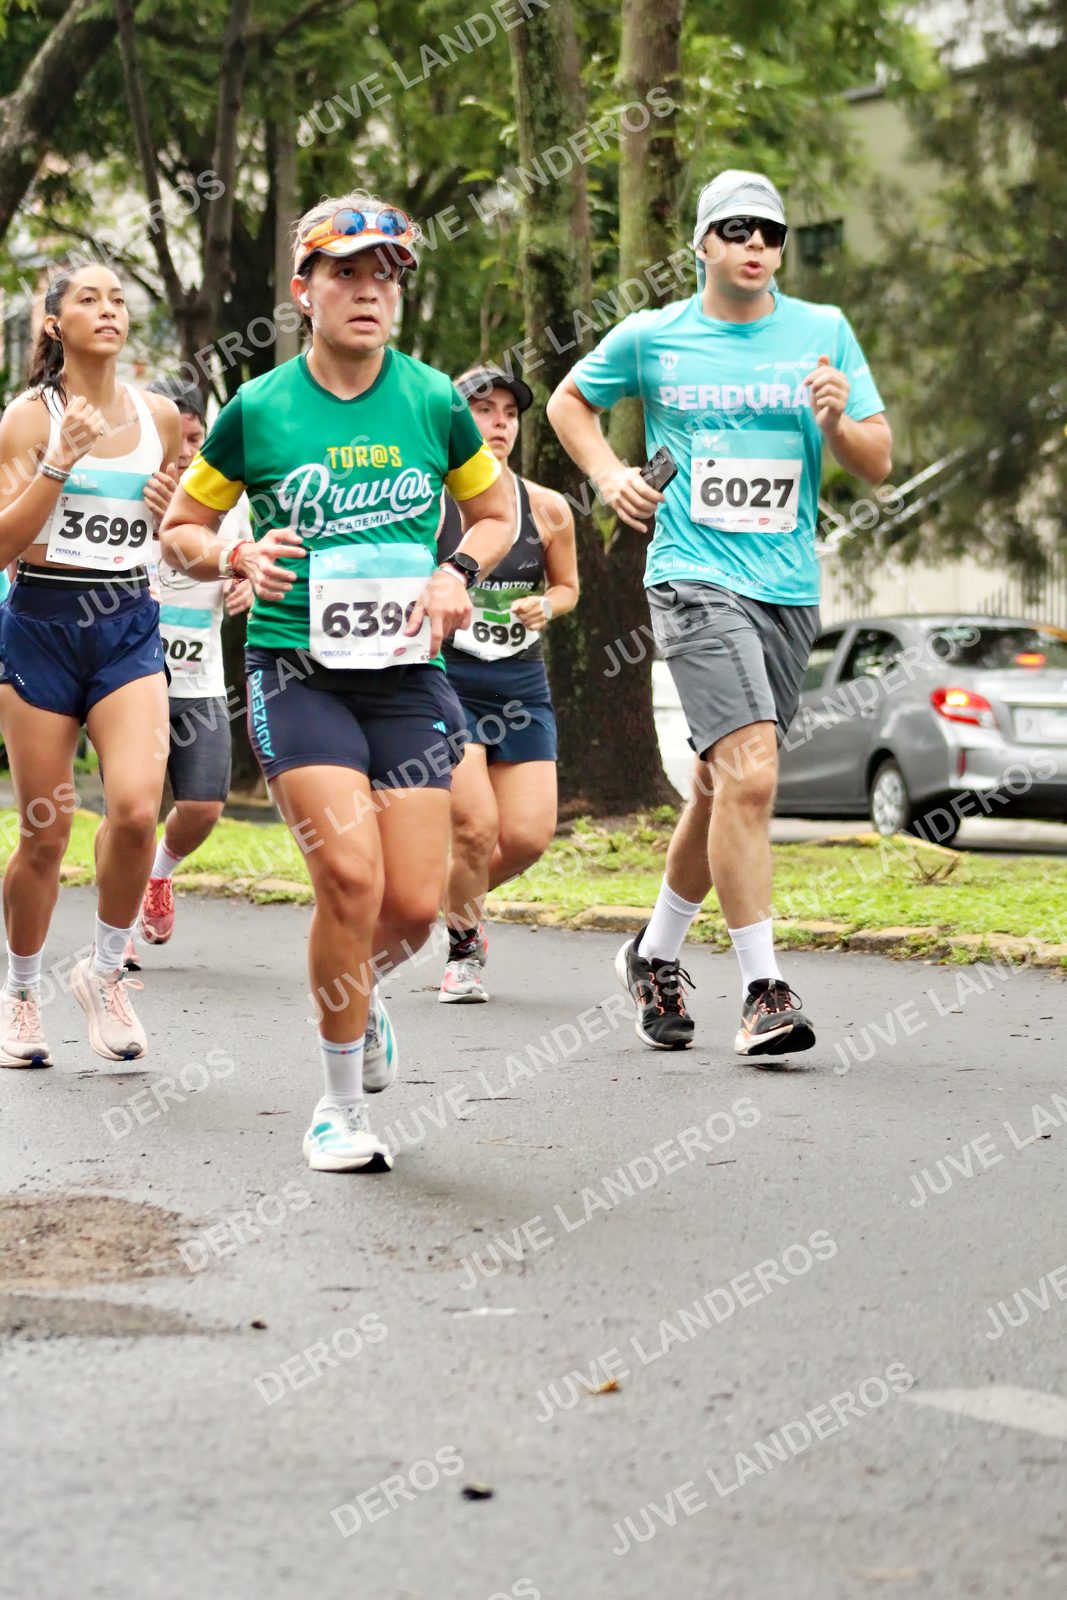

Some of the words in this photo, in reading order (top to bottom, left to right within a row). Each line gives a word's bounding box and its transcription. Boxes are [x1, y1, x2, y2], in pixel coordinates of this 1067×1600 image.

[658, 383, 812, 411] PERDURA
[327, 444, 402, 469] TOR@S
[277, 463, 434, 538] Brav@s
[700, 476, 795, 508] 6027
[58, 509, 148, 549] 3699
[329, 513, 390, 533] ACADEMIA
[478, 580, 534, 591] GARITOS
[472, 621, 526, 647] 699
[250, 669, 275, 757] ADIZERO
